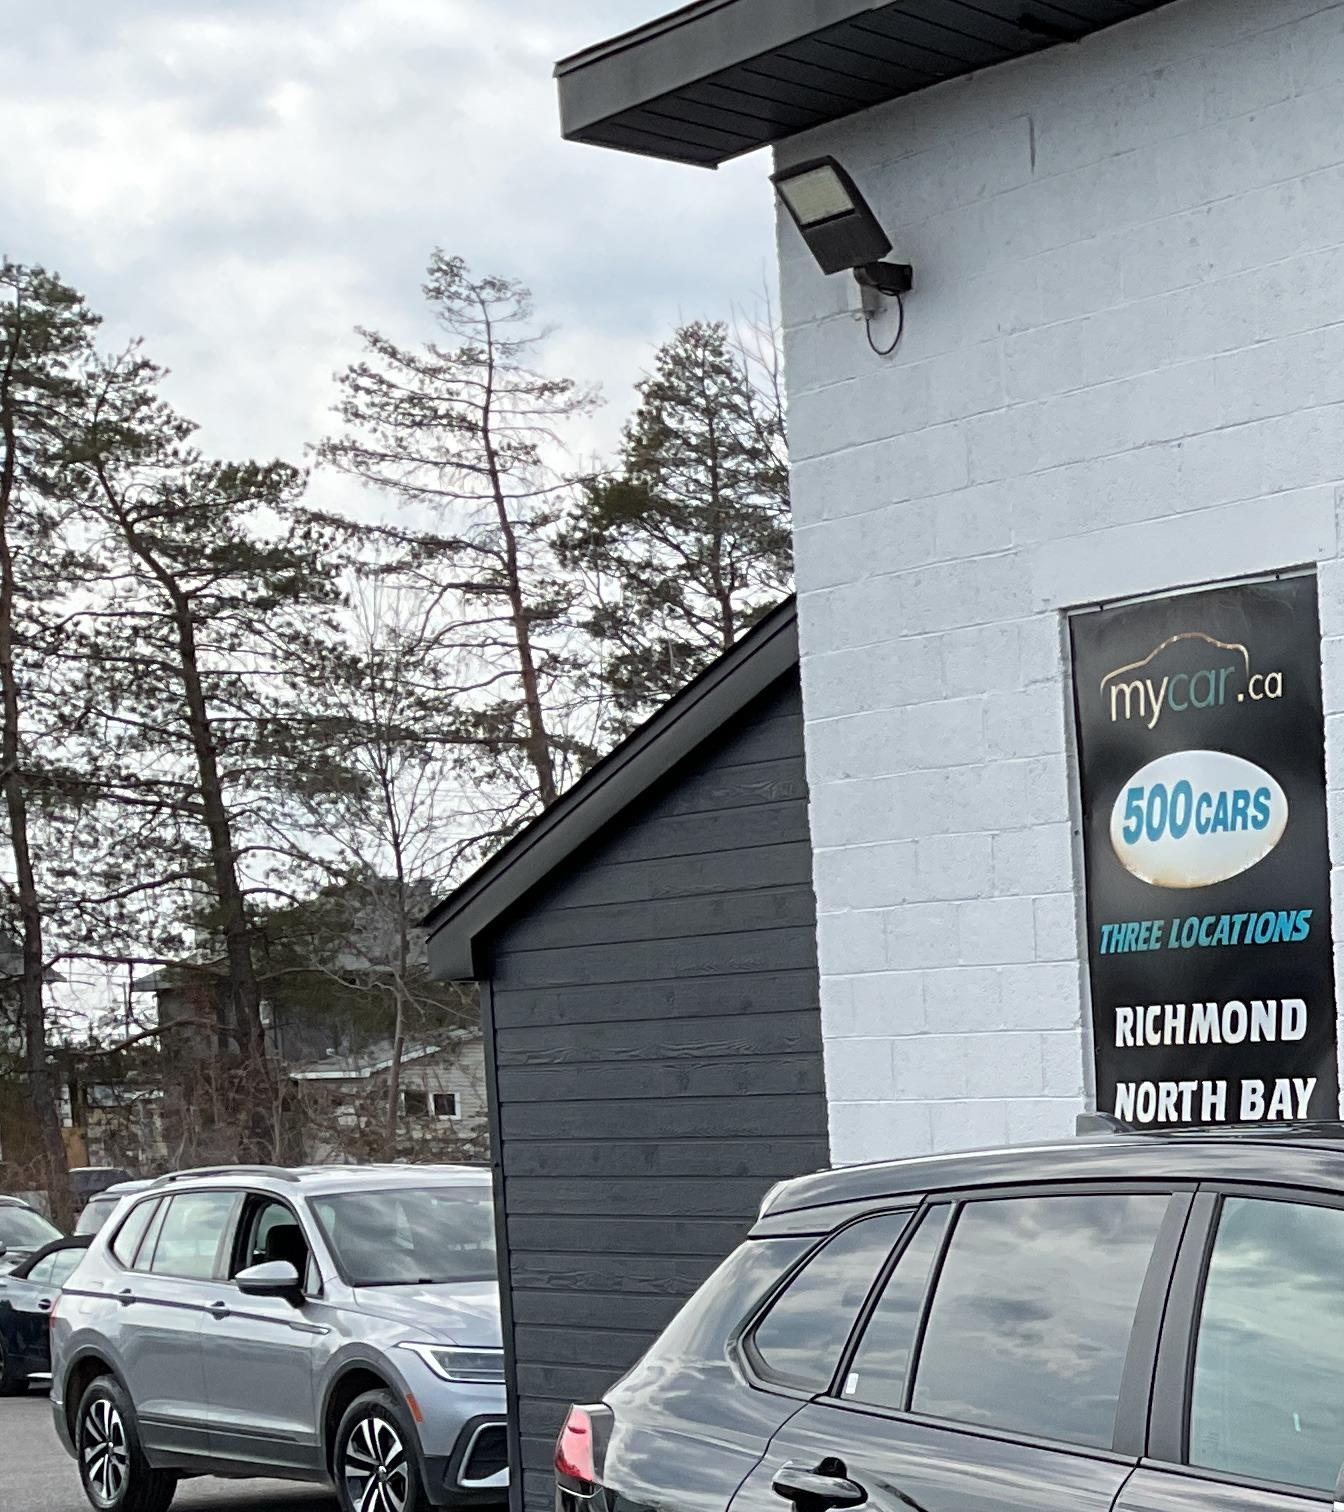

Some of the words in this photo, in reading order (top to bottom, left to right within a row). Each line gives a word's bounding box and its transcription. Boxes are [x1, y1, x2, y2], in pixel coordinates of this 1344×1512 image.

[1108, 665, 1283, 729] mycar.ca
[1100, 918, 1163, 955] THREE
[1168, 907, 1314, 949] LOCATIONS
[1114, 998, 1308, 1048] RICHMOND
[1113, 1079, 1227, 1123] NORTH
[1239, 1077, 1318, 1121] BAY
